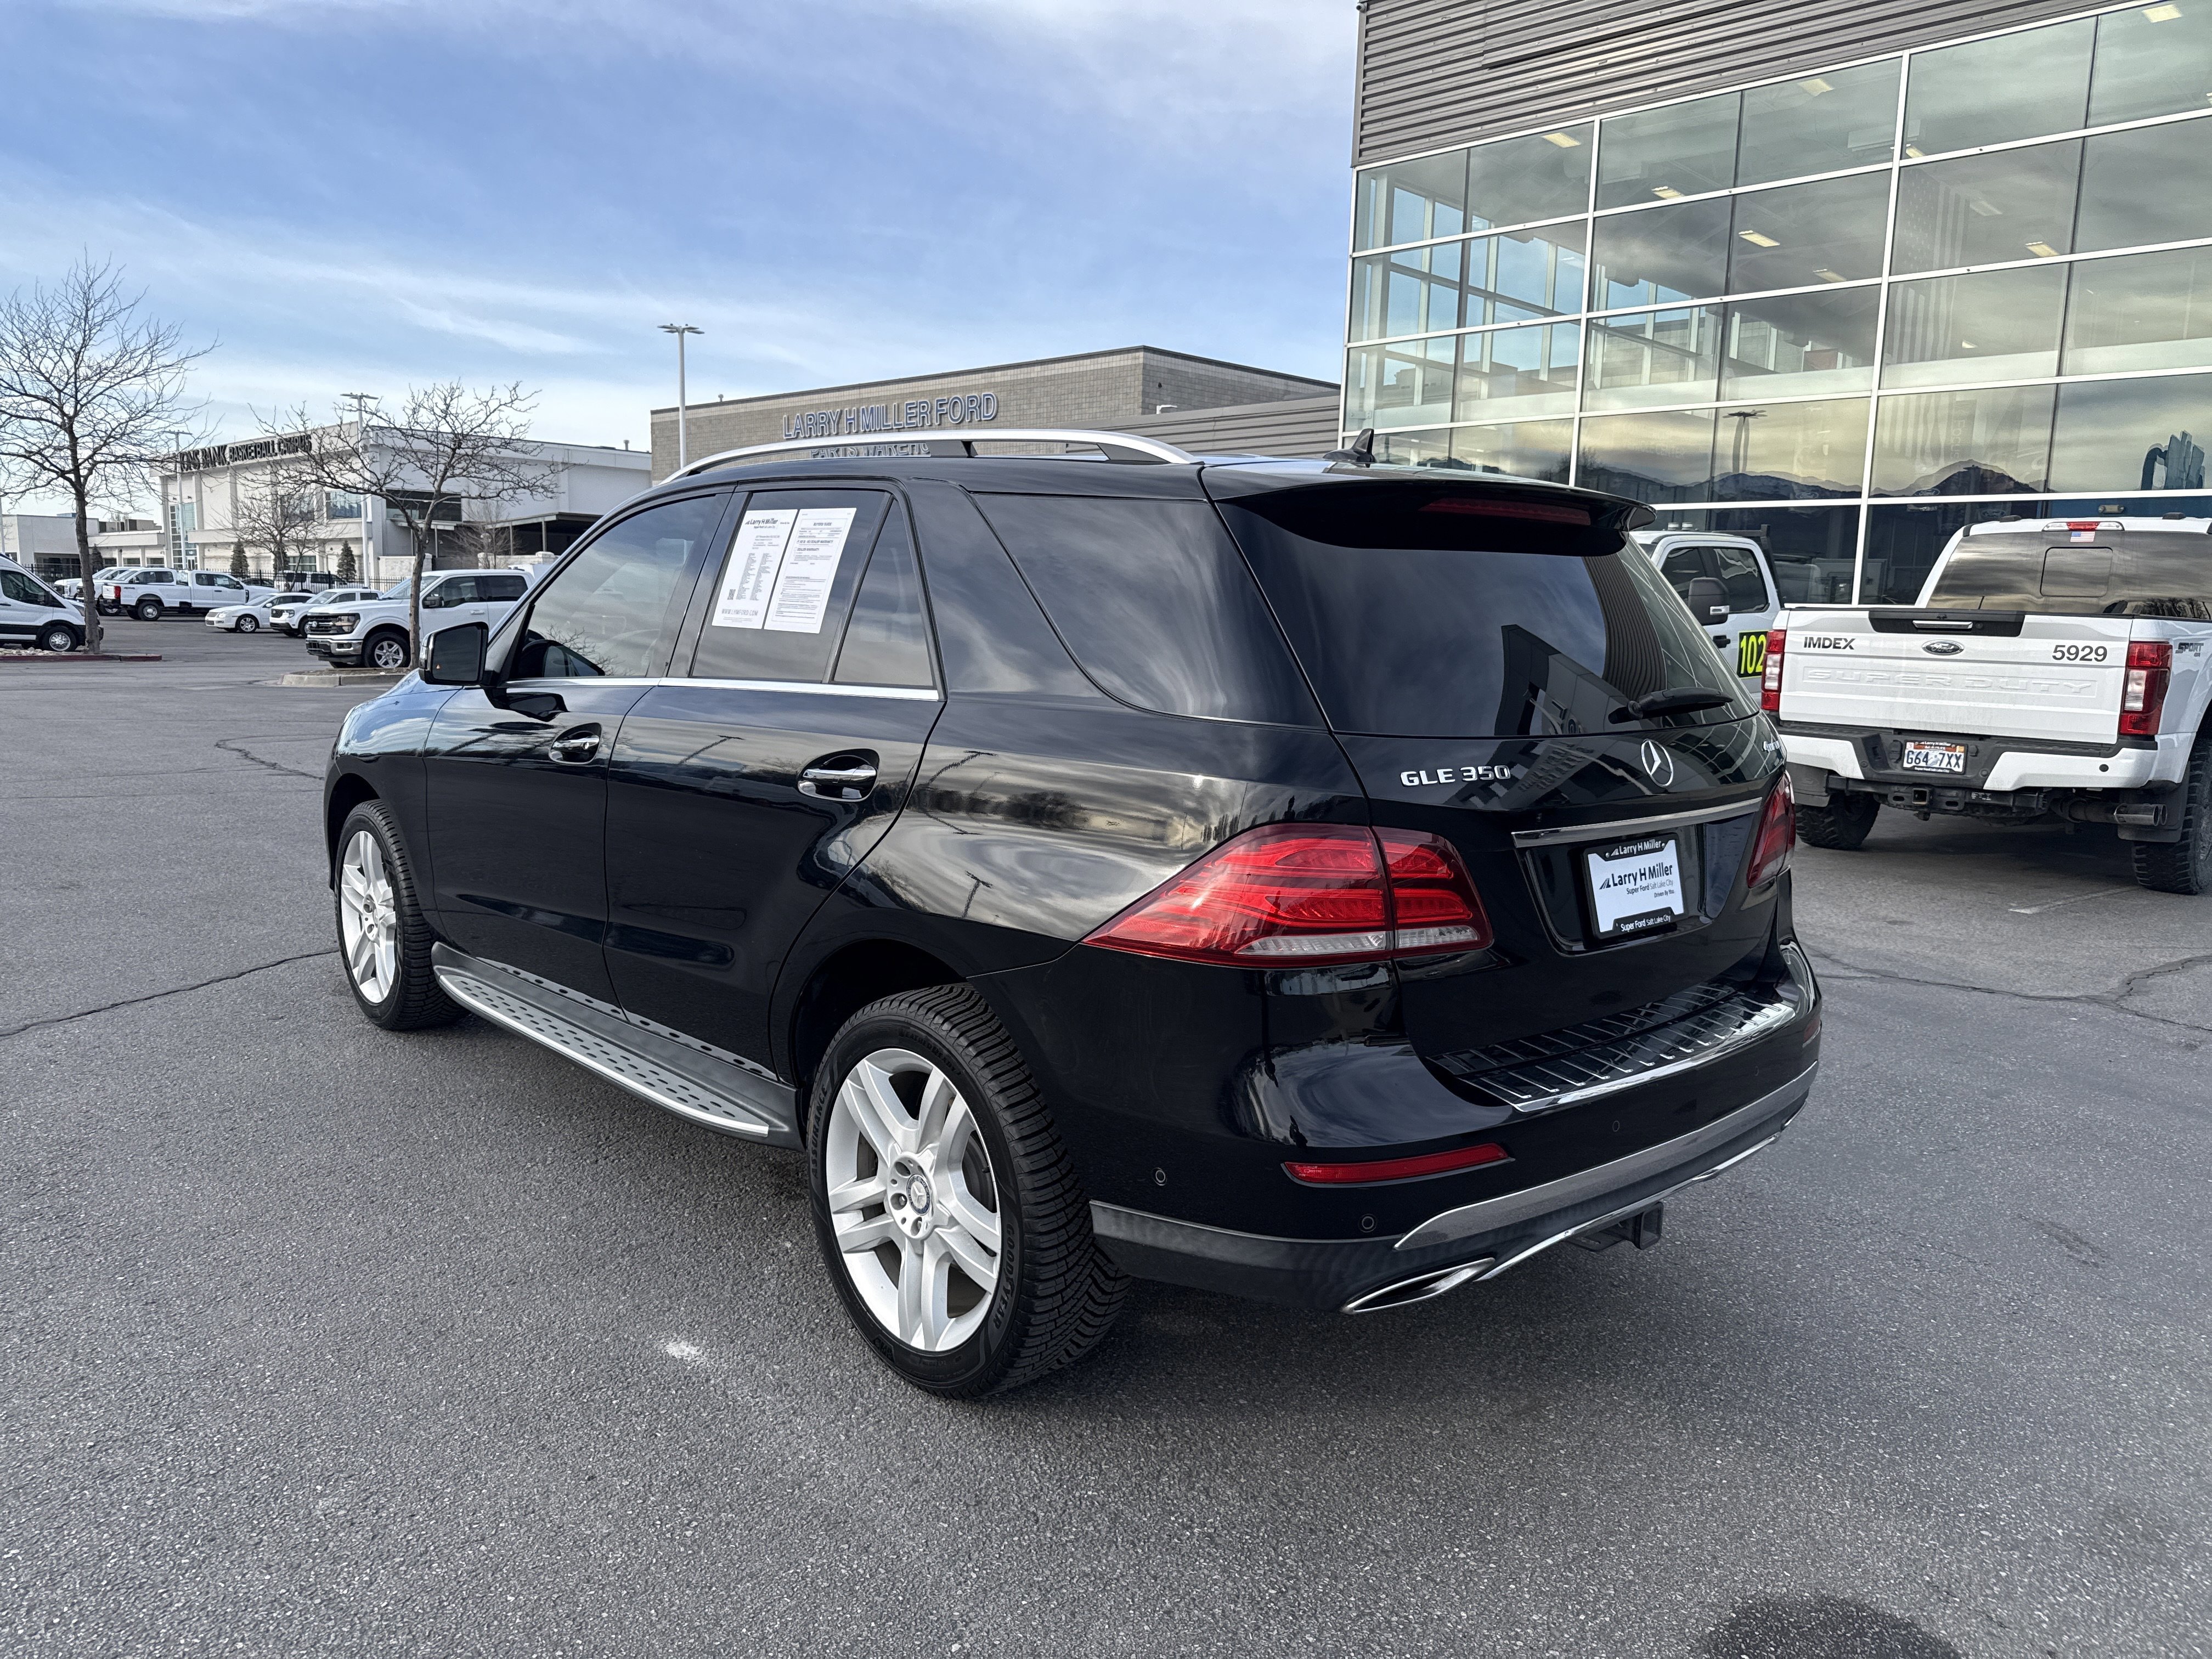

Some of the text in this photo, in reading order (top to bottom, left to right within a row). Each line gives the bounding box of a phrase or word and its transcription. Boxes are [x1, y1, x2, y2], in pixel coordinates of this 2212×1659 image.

[783, 393, 998, 439] LARRY H MILLER FORD
[173, 450, 201, 472] IONS
[228, 440, 278, 462] BASKETBALL
[1803, 636, 1856, 650] IMDEX
[2052, 644, 2108, 663] 5929
[2175, 642, 2204, 654] SPORT
[1740, 634, 1767, 674] 102
[1807, 668, 2094, 693] SUPER DUTY
[1906, 750, 1962, 769] G64 7XX
[1400, 765, 1511, 786] GLE 350
[1619, 839, 1661, 855] Larry H Miller
[1611, 862, 1673, 887] Larry H Miller
[1640, 883, 1649, 891] Ford
[1621, 922, 1635, 932] Super
[1635, 918, 1645, 928] Ford
[1654, 916, 1663, 924] Lake
[811, 1084, 827, 1179] ASSURANCE
[993, 1223, 1015, 1330] GOODYEAR
